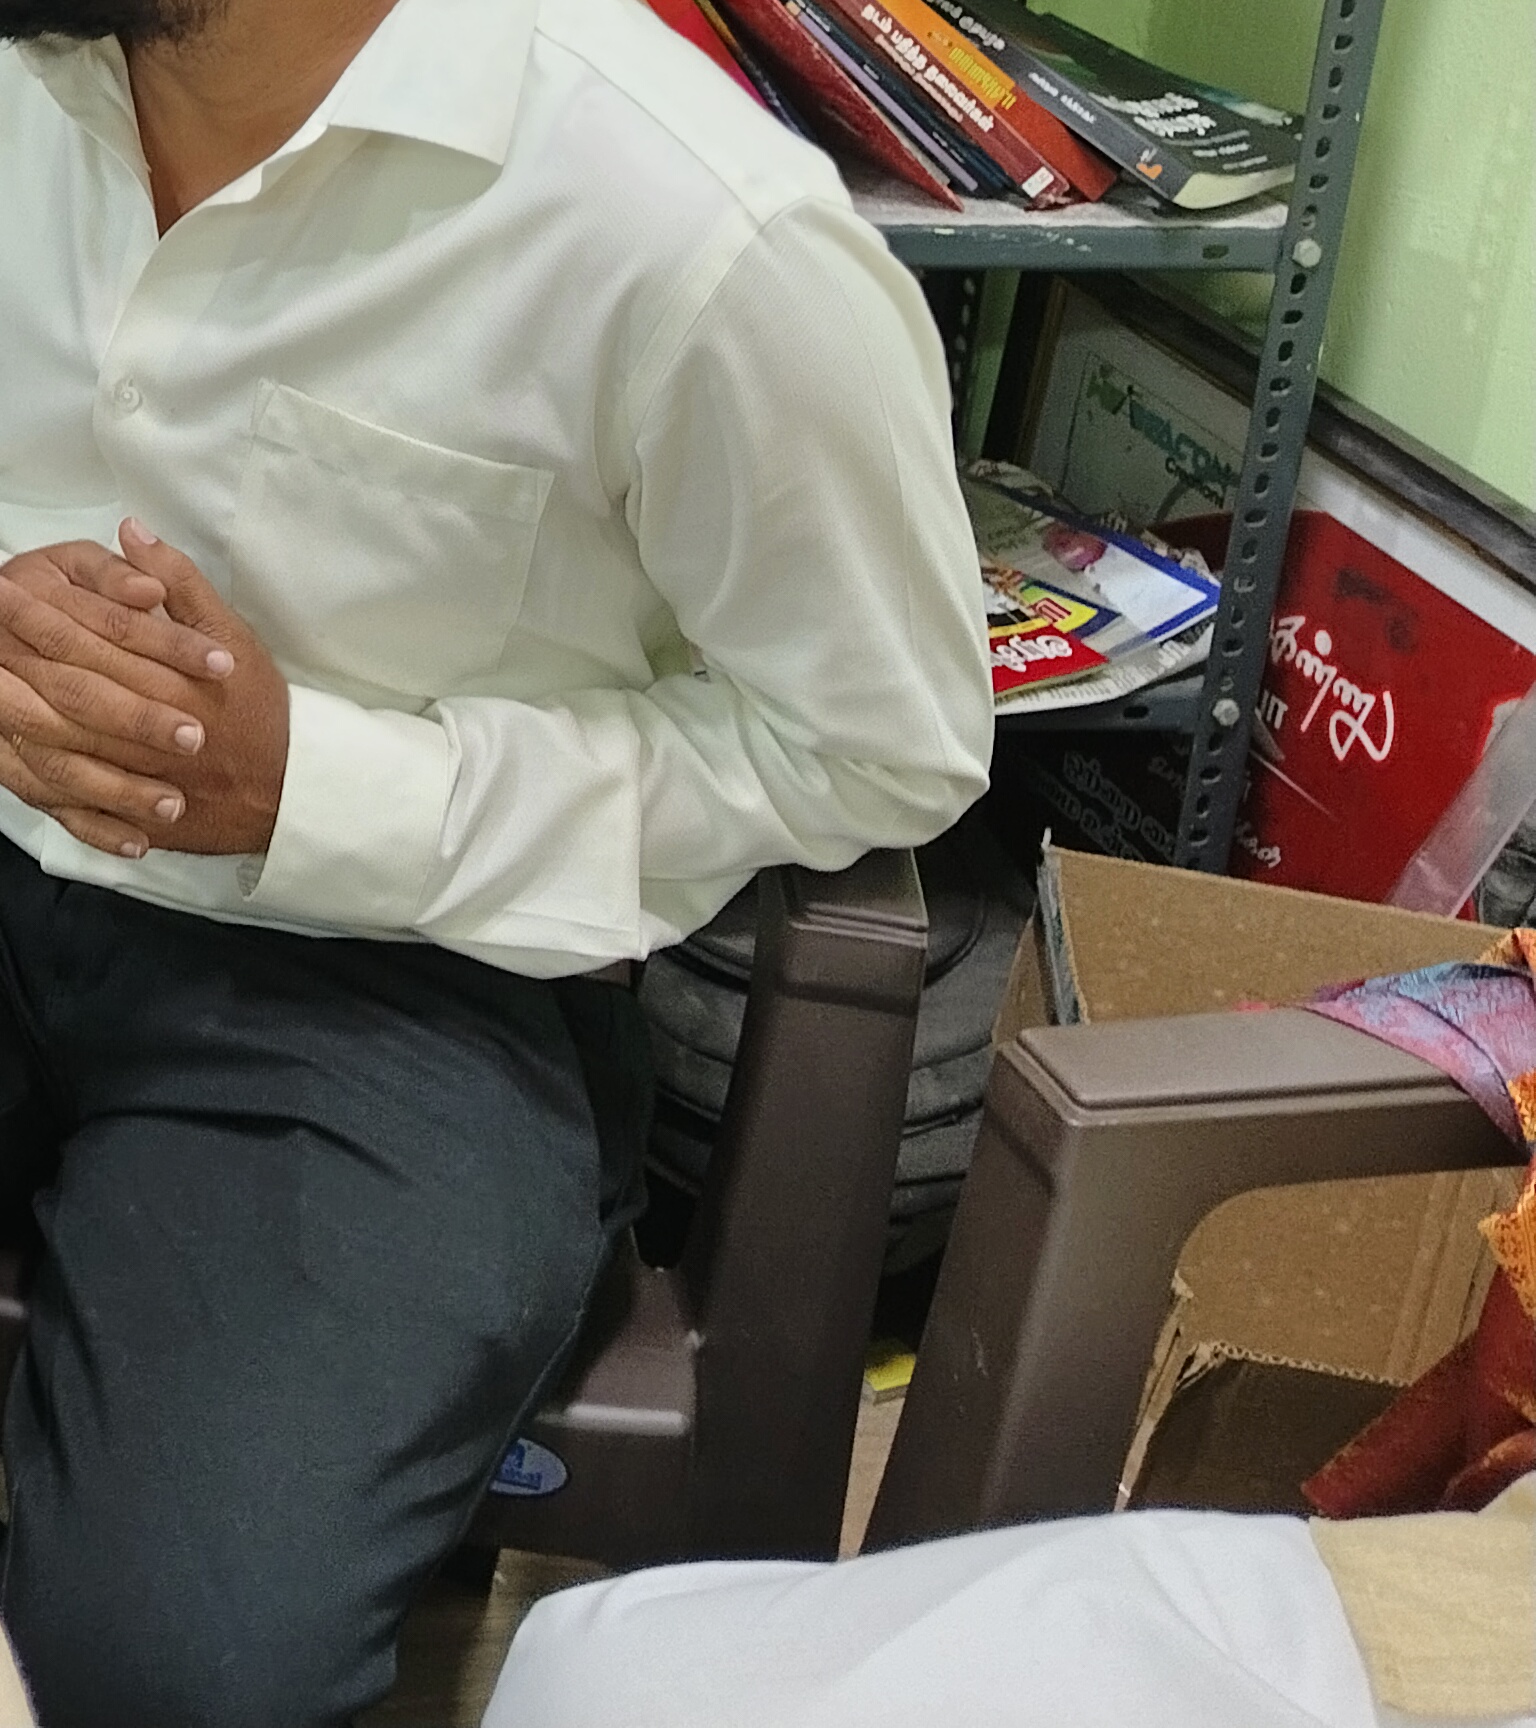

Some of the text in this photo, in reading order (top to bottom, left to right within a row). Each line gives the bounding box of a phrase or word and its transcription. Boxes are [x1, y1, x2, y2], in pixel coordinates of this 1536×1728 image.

[858, 0, 896, 36] தடம்
[885, 26, 932, 72] பதித்த
[921, 62, 998, 134] தலைவர்கள்
